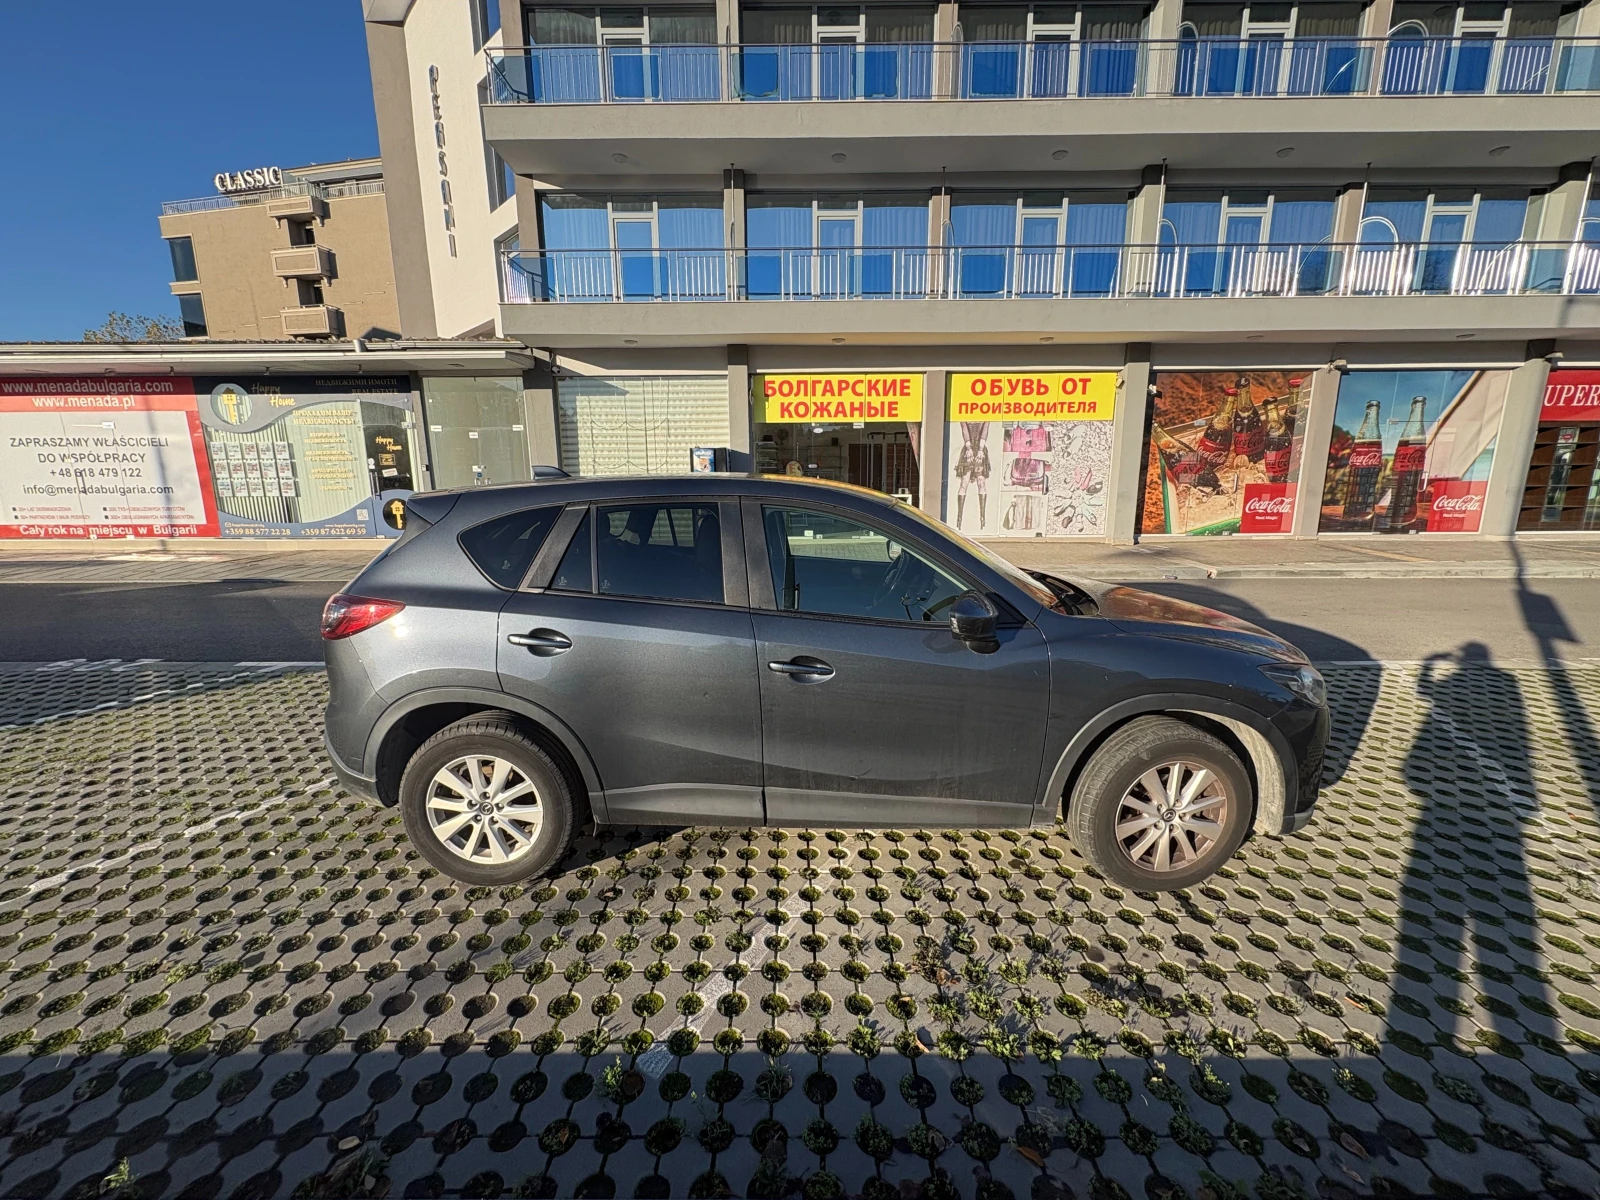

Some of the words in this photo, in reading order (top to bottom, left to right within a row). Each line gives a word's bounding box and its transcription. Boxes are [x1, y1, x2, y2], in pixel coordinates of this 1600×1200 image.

[214, 166, 280, 191] CLASSIC
[2, 379, 174, 395] www.menadabulgaria.com
[251, 382, 281, 396] Happy
[764, 379, 911, 398] БОЛГАРСКИЕ
[970, 378, 1050, 397] ОБУВЬ
[1061, 377, 1092, 396] ОТ
[32, 395, 135, 409] www.menada.pl
[270, 395, 296, 408] Home
[1543, 384, 1600, 407] UPER
[780, 401, 899, 418] КОЖАНЫЕ
[958, 401, 1097, 416] ПРОИЗВОДИТЕЛЯ
[10, 438, 90, 447] ZAPRASZAMY
[92, 435, 169, 447] WŁAŚCICIELI
[38, 454, 56, 463] DO
[59, 451, 146, 463] WSPÓŁPRACY
[98, 468, 119, 477] 479
[122, 468, 142, 477] 122
[23, 485, 174, 496] info@menadabulgaria.com
[1245, 497, 1294, 513] Coca-Cola
[1434, 495, 1484, 511] Coca-Cola
[20, 525, 45, 537] Cały
[48, 525, 68, 535] rok
[69, 527, 84, 535] na
[89, 526, 133, 537] miejscu
[153, 524, 197, 537] Bułgarii
